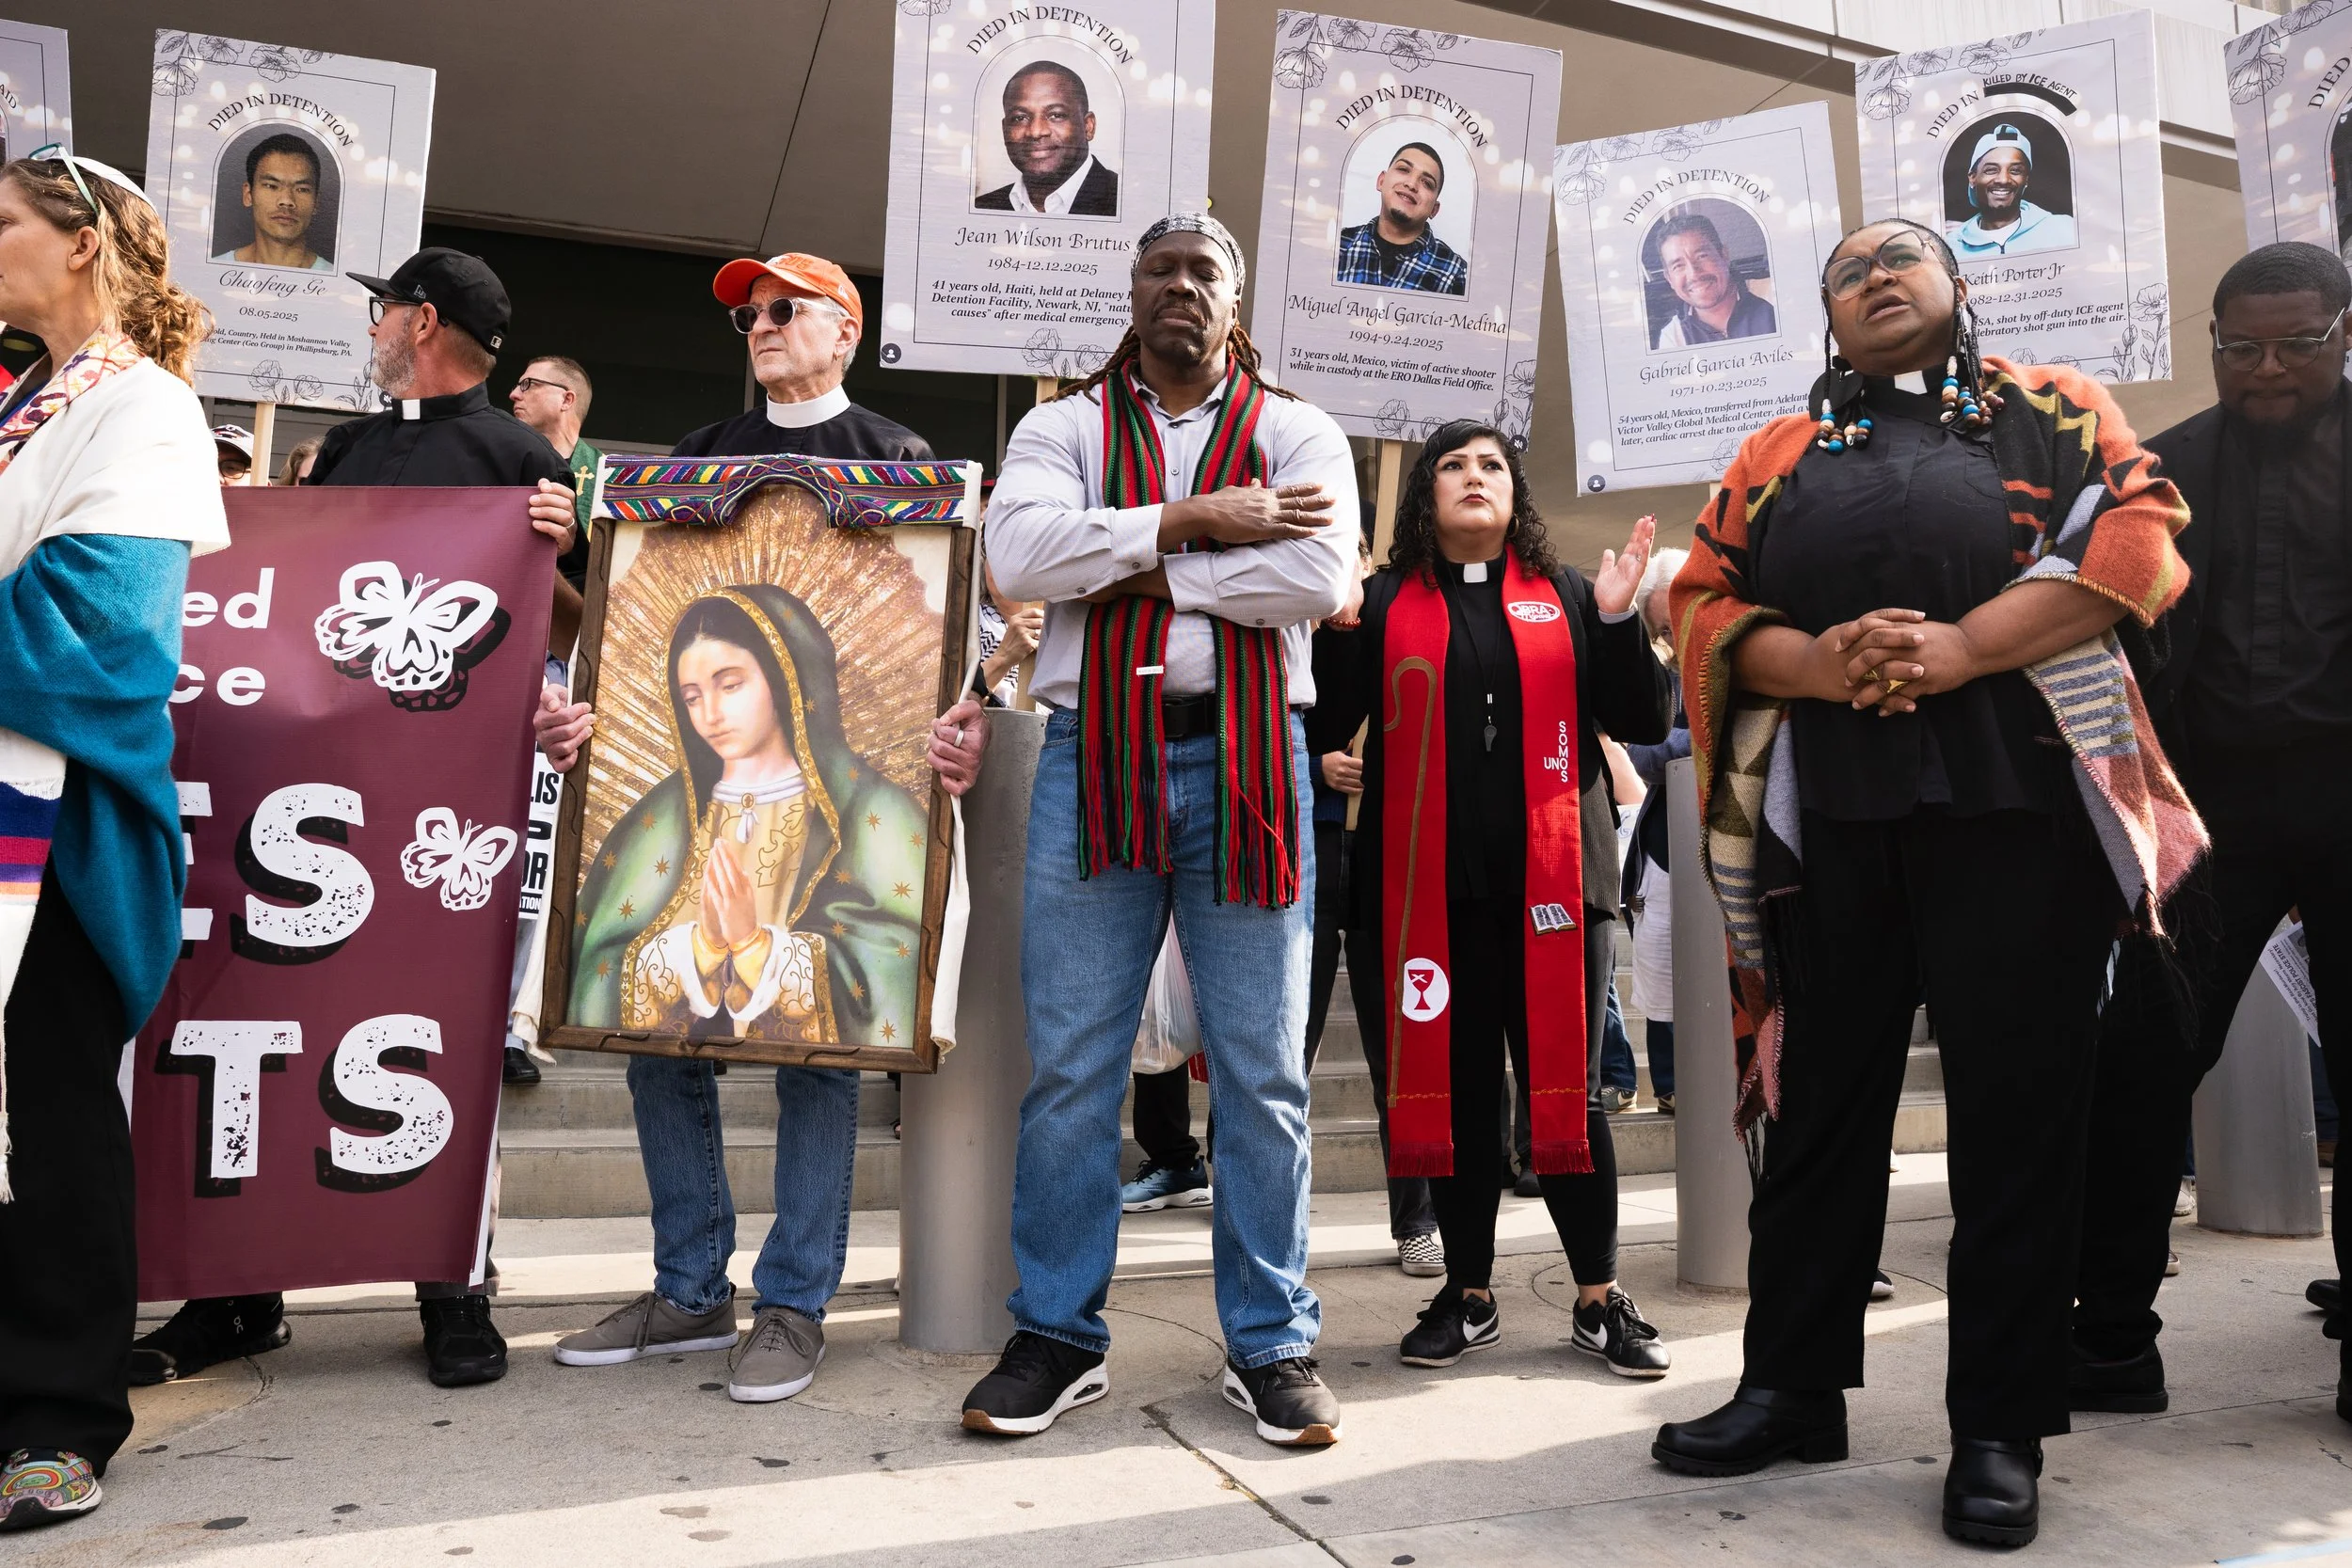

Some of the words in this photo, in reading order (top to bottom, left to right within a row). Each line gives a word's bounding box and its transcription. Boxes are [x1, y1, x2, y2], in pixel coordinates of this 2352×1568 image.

[966, 18, 1007, 55] DIED
[1009, 8, 1030, 25] IN
[1036, 6, 1134, 65] DETENTION
[1982, 73, 2011, 87] KILLED
[2015, 73, 2028, 83] BY
[2028, 73, 2048, 87] ICE
[2047, 81, 2078, 99] AGENT
[2308, 57, 2350, 109] DIED
[208, 102, 244, 132] DIED
[246, 94, 264, 108] IN
[270, 93, 353, 147] DETENTION
[1336, 95, 1374, 130] DIED
[1375, 86, 1395, 102] IN
[1401, 85, 1488, 148] DETENTION
[1927, 103, 1959, 138] DIED
[1960, 90, 1979, 107] IN
[1624, 190, 1655, 225] DIED
[1655, 177, 1675, 194] IN
[1677, 168, 1771, 204] DETENTION
[954, 227, 997, 246] Jean
[1004, 228, 1063, 248] Wilson
[1069, 233, 1130, 252] Brutus
[987, 257, 1099, 276] 1984-12.12.2025
[1962, 268, 1998, 286] Keith
[2002, 267, 2048, 283] Porter
[2047, 262, 2066, 280] Jr
[219, 270, 297, 297] Chaofeng
[303, 278, 327, 295] Ge
[931, 280, 946, 290] 41
[948, 282, 978, 293] years
[980, 282, 1002, 295] old,
[1005, 284, 1036, 296] Haiti,
[1040, 286, 1062, 296] held
[1065, 289, 1077, 297] at
[1080, 288, 1124, 301] Delaney
[931, 293, 985, 305] Detention
[988, 295, 1032, 309] Facility,
[1035, 298, 1081, 311] Newark,
[1084, 301, 1101, 313] NJ,
[1967, 287, 2063, 308] 982-12.31.2025
[239, 307, 298, 322] 08.05.2025
[951, 308, 992, 319] causes"
[994, 309, 1021, 321] after
[1024, 310, 1066, 323] medical
[1069, 314, 1129, 327] emergency.
[1288, 294, 1346, 319] Miguel
[1346, 301, 1393, 325] Angel
[1996, 314, 2017, 325] shot
[2020, 312, 2032, 324] by
[2033, 309, 2074, 322] off-duty
[2075, 305, 2094, 315] ICE
[2096, 302, 2124, 314] agent
[2023, 323, 2044, 333] shot
[2046, 323, 2065, 332] gun
[2068, 318, 2088, 327] into
[2090, 315, 2106, 325] the
[2106, 313, 2127, 323] air.
[217, 337, 241, 346] Center
[242, 340, 259, 348] (Geo
[260, 342, 285, 351] Group)
[295, 344, 339, 356] Phillipsburg,
[341, 348, 352, 356] PA.
[229, 329, 258, 340] Country,
[260, 332, 277, 341] Held
[287, 335, 327, 345] Moshannon
[329, 340, 351, 348] Valley
[1349, 330, 1444, 351] 1994-9.24.2025
[1290, 347, 1302, 356] 31
[1304, 350, 1329, 360] years
[1332, 352, 1349, 363] old,
[1351, 354, 1388, 368] Mexico,
[1391, 358, 1419, 371] victim
[1421, 361, 1433, 373] of
[1433, 364, 1459, 374] active
[1461, 367, 1497, 379] shooter
[1640, 357, 1694, 385] Gabriel
[1749, 344, 1793, 366] Aviles
[1289, 360, 1314, 372] while
[1316, 363, 1326, 372] in
[1327, 365, 1361, 378] custody
[1363, 369, 1373, 377] at
[1374, 369, 1390, 379] the
[1391, 372, 1412, 382] ERO
[1412, 374, 1441, 386] Dallas
[1443, 377, 1465, 388] Field
[1466, 379, 1494, 392] Office.
[1671, 376, 1767, 398] 1971-10.23.2025
[1617, 425, 1644, 436] Victor
[1646, 421, 1673, 434] Valley
[1674, 418, 1703, 429] Global
[1705, 413, 1741, 425] Medical
[1742, 409, 1774, 420] Center,
[1776, 404, 1796, 416] died
[1618, 416, 1629, 425] 54
[1629, 414, 1653, 425] years
[1654, 411, 1670, 421] old,
[1671, 407, 1703, 420] Mexico,
[1704, 399, 1751, 414] transferred
[1752, 398, 1773, 409] from
[1774, 393, 1809, 404] Adelant
[1621, 436, 1644, 447] later,
[1645, 432, 1677, 443] cardiac
[1679, 429, 1706, 439] arrest
[1708, 426, 1724, 436] due
[1725, 425, 1735, 434] to
[2272, 943, 2285, 959] STATE
[2282, 958, 2297, 977] POLICE
[2295, 976, 2312, 998] FASCIST
